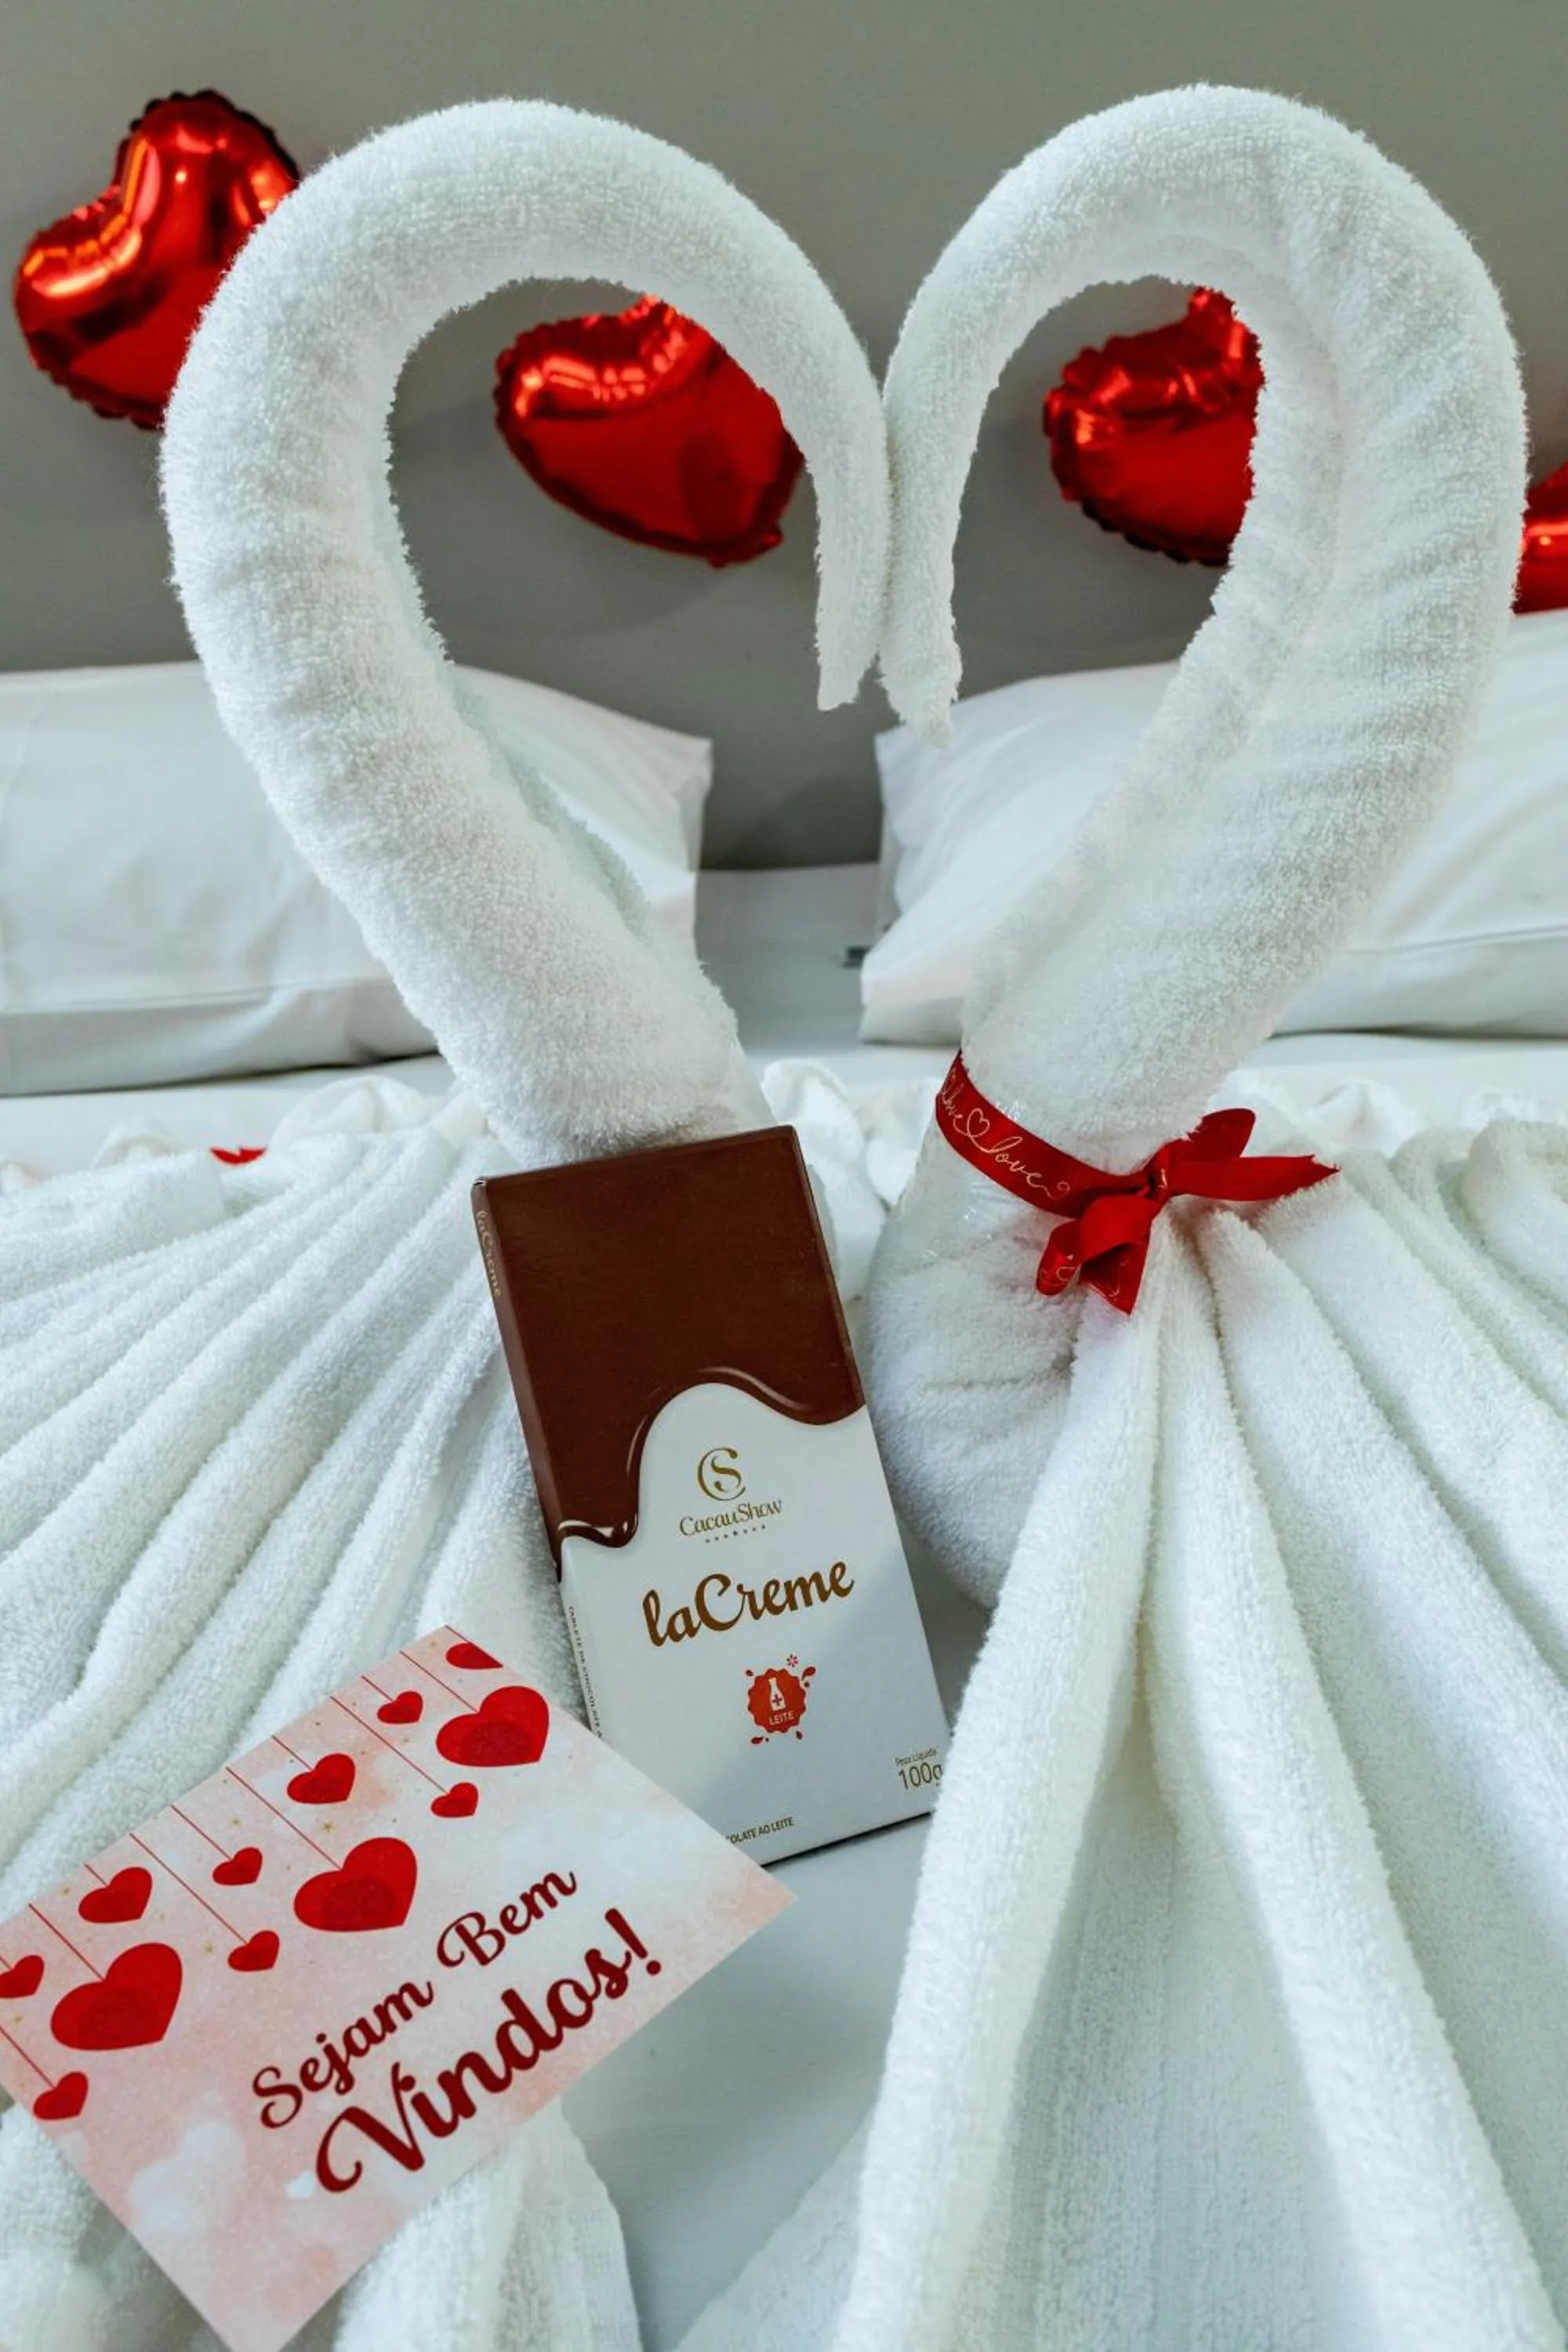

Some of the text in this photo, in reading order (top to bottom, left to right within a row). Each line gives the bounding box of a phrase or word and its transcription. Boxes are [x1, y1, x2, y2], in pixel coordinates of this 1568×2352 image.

[984, 1136, 1051, 1196] love
[680, 1499, 782, 1537] CacauShow
[642, 1562, 855, 1647] laCreme
[769, 1710, 794, 1726] LEITE
[725, 1816, 794, 1845] OLATE AO LEITE
[252, 1871, 578, 2129] Sejam Bem
[316, 1907, 662, 2193] Vindos!
